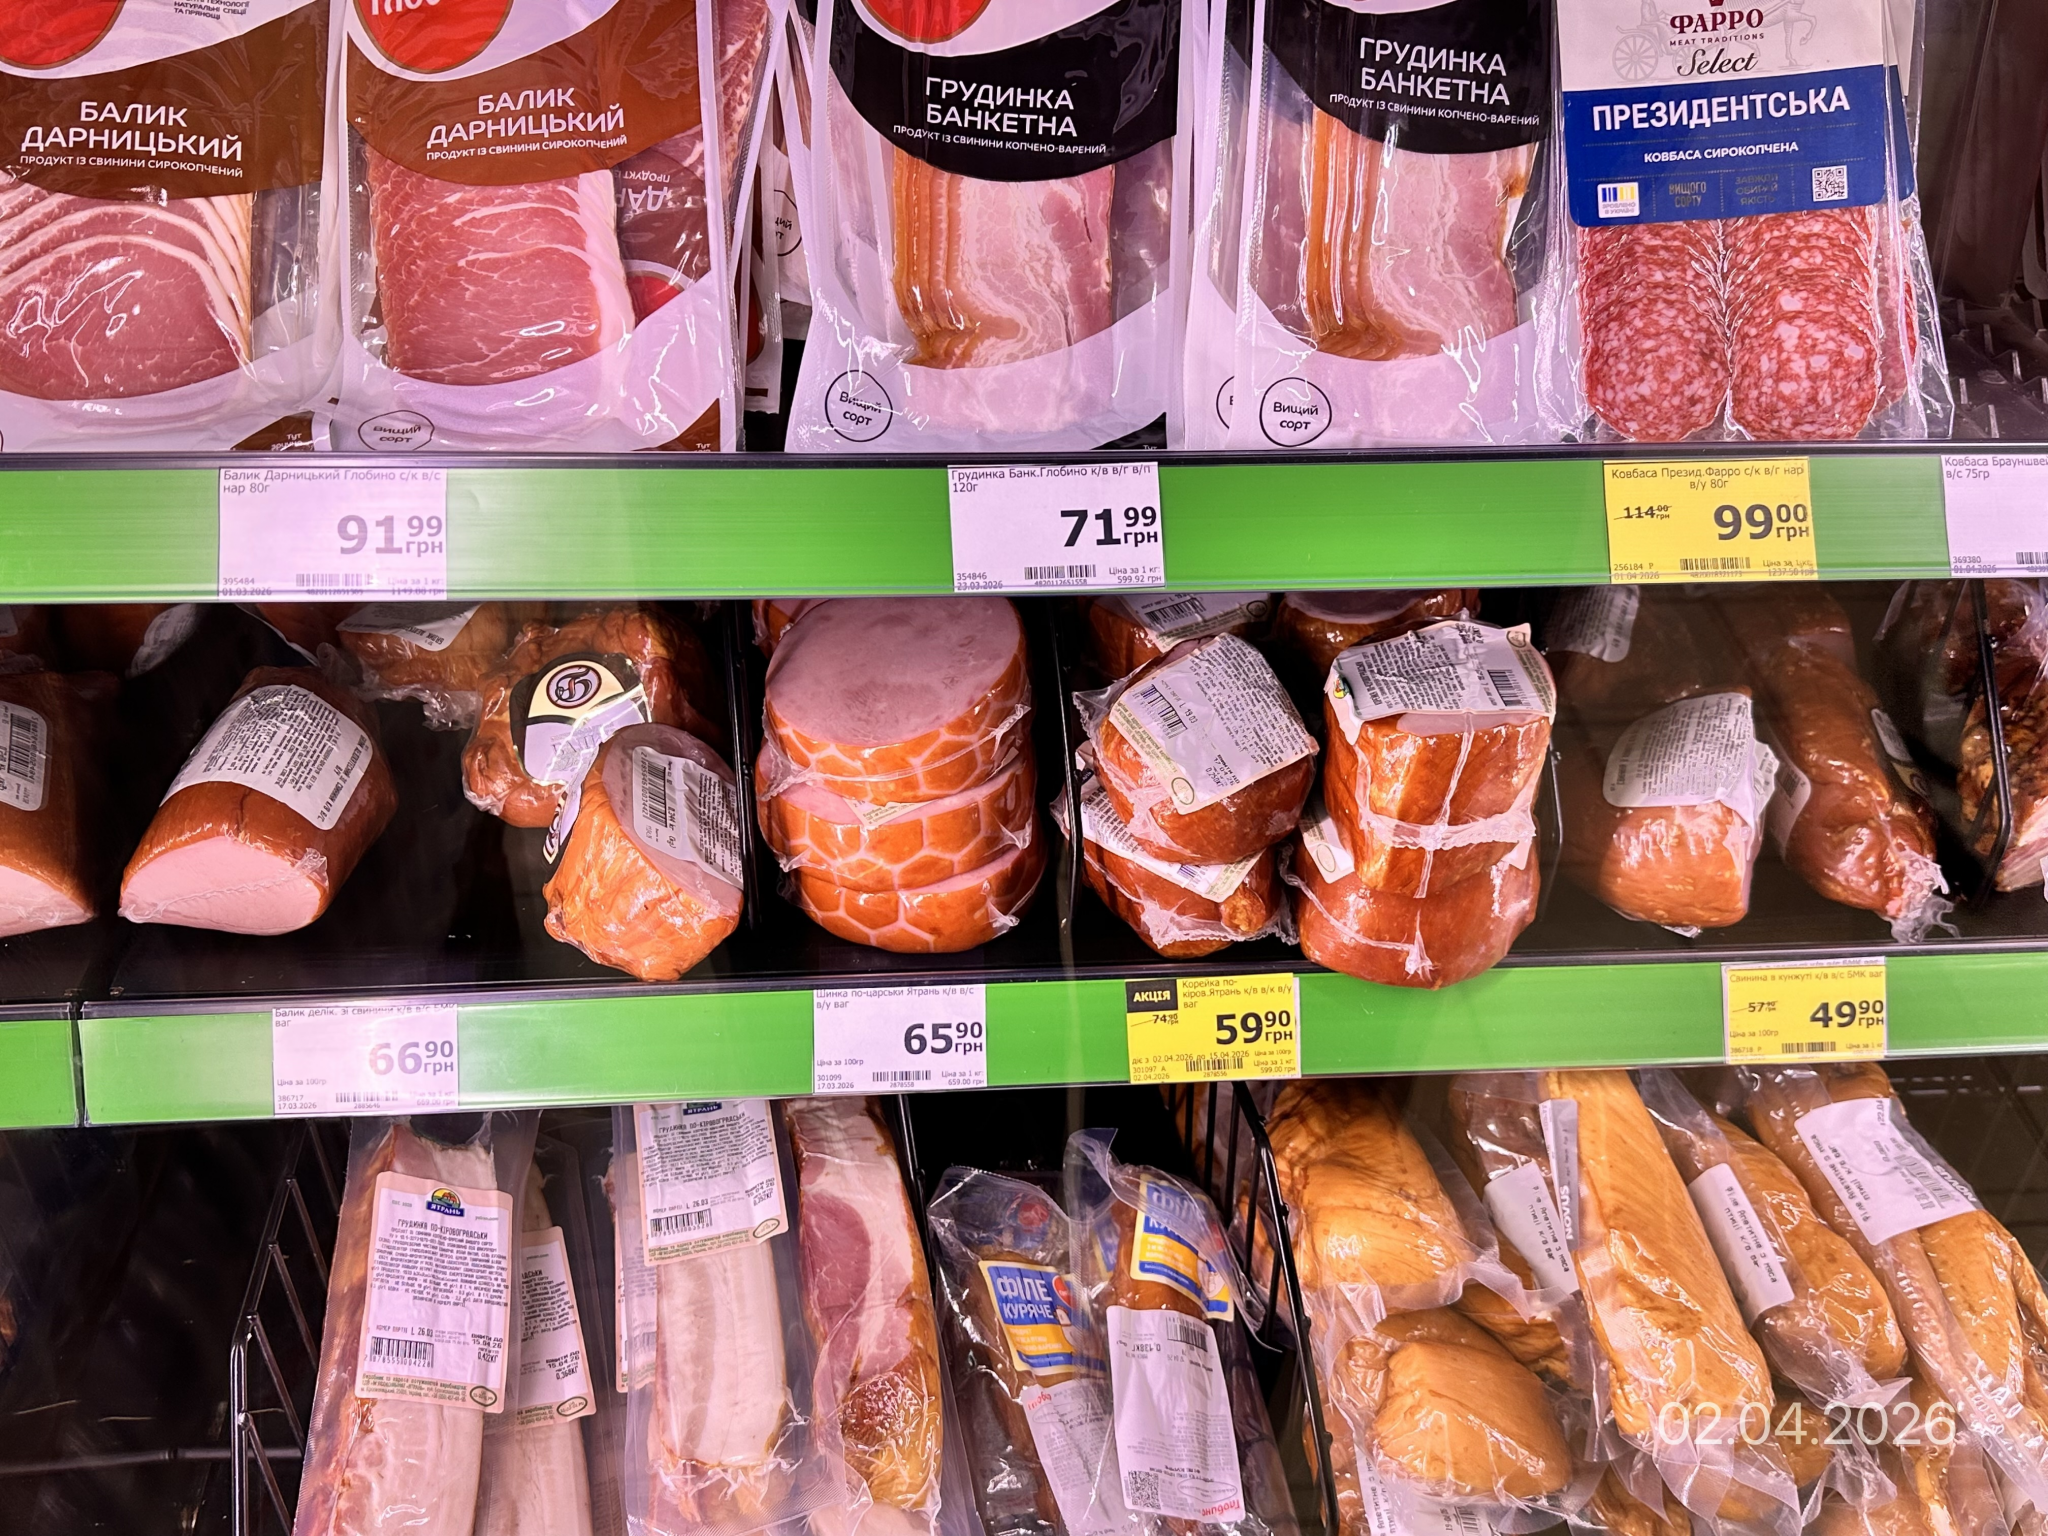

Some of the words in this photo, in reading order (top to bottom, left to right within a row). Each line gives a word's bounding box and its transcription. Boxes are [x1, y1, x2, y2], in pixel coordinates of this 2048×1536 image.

[1670, 8, 1764, 34] ФАРРО
[1670, 38, 1697, 46] MEAT
[1701, 33, 1765, 43] TRADITIONS
[1360, 37, 1506, 76] ГРУДИНКА
[1677, 48, 1759, 77] Select
[926, 76, 1074, 110] ГРУДИНКА
[1361, 67, 1510, 106] БАНКЕТНА
[478, 87, 575, 114] БАЛИК
[80, 101, 188, 127] БАЛИК
[1329, 94, 1374, 109] ПРОДУКТ
[1377, 101, 1385, 110] ІЗ
[1388, 102, 1436, 117] СВИНИНИ
[1438, 109, 1540, 125] КОПЧЕНО-ВАРЕНИЙ
[1593, 85, 1851, 131] ПРЕЗИДЕНТСЬКА
[427, 103, 624, 149] ДАРНИЦЬКИЙ
[927, 103, 1077, 137] БАНКЕТНА
[21, 126, 242, 161] ДАРНИЦЬКИЙ
[893, 125, 939, 141] ПРОДУКТ
[942, 134, 951, 143] ІЗ
[953, 135, 1003, 149] СВИНИНИ
[1005, 141, 1106, 154] КОПЧЕНО-ВАРЕНИЙ
[427, 148, 474, 160] ПРОДУКТ
[477, 148, 487, 156] ІЗ
[489, 142, 540, 155] СВИНИНИ
[542, 135, 627, 150] СИРОКОПЧЕНИЙ
[1644, 150, 1702, 163] КОВБАСА
[1704, 141, 1799, 160] СИРОКОПЧЕНА
[20, 156, 73, 167] ПРОДУКТ
[77, 157, 86, 165] ІЗ
[88, 157, 145, 168] СВИНИНИ
[148, 160, 243, 178] СИРОКОПЧЕНИЙ
[623, 170, 670, 183] ПРОДУКТ
[1669, 182, 1707, 195] ВИЩОГО
[1674, 195, 1702, 208] СОРТУ
[1273, 402, 1318, 416] Вищий
[843, 411, 872, 425] сорт
[1280, 420, 1311, 431] сорт
[1945, 457, 1988, 467] Ковбаса
[223, 470, 260, 480] Балик
[264, 470, 340, 482] Дарницький
[344, 470, 396, 480] Глобино
[400, 470, 418, 481] с/к
[422, 470, 441, 481] в/с
[951, 470, 1005, 481] Грудинка
[1009, 467, 1087, 479] Банк.Глобино
[1091, 466, 1108, 477] к/в
[1112, 465, 1129, 476] в/г
[1133, 465, 1150, 475] в/п
[1612, 468, 1657, 479] Ковбаса
[1662, 467, 1740, 479] Презид.Фарро
[1744, 466, 1761, 477] с/к
[1765, 466, 1780, 476] в/г
[1784, 466, 1804, 475] нар
[1946, 469, 1963, 480] в/с
[1966, 469, 1990, 480] 75гр
[223, 485, 245, 495] нар
[249, 483, 270, 493] 80г
[952, 482, 979, 492] 120г
[1690, 480, 1706, 490] в/у
[1710, 479, 1729, 489] 80г
[1623, 506, 1655, 519] 114
[1060, 508, 1121, 547] 71
[1124, 506, 1157, 527] 99
[1713, 504, 1773, 541] 99
[1776, 504, 1808, 523] 00
[337, 514, 403, 555] 91
[406, 515, 443, 537] 99
[1123, 531, 1158, 547] грн
[1776, 526, 1809, 541] грн
[406, 541, 443, 557] грн
[1109, 567, 1128, 575] Ціна
[1614, 563, 1643, 571] 256184
[957, 572, 987, 580] 354846
[1117, 575, 1145, 583] 599.92
[1730, 974, 1768, 982] Свинина
[1778, 972, 1812, 981] кунжуті
[1814, 971, 1828, 980] к/в
[1831, 970, 1844, 979] в/с
[1847, 970, 1866, 978] БМК
[1182, 979, 1220, 988] Корейка
[1223, 979, 1238, 987] по-
[1244, 987, 1258, 995] к/в
[1261, 986, 1275, 994] в/к
[1277, 985, 1292, 994] в/у
[816, 989, 848, 998] Шинка
[851, 989, 904, 997] по-царськи
[907, 988, 940, 996] Ятрань
[942, 987, 957, 995] к/в
[960, 986, 974, 994] в/с
[1133, 991, 1171, 1002] АКЦІЯ
[816, 1001, 831, 1010] в/у
[1748, 1002, 1764, 1012] 57
[275, 1008, 305, 1017] Балик
[308, 1008, 338, 1018] делік.
[1152, 1014, 1167, 1024] 74
[1809, 1001, 1856, 1028] 49
[1859, 1000, 1883, 1014] 90
[1216, 1012, 1263, 1045] 59
[1264, 1010, 1291, 1027] 90
[1859, 1017, 1884, 1028] грн
[904, 1023, 953, 1055] 65
[956, 1022, 983, 1038] 90
[1265, 1030, 1293, 1044] грн
[955, 1042, 983, 1055] грн
[368, 1042, 422, 1076] 66
[425, 1040, 454, 1058] 90
[844, 1058, 864, 1066] 100гр
[1152, 1054, 1194, 1063] 02.04.2026
[1209, 1051, 1250, 1060] 15.04.2026
[424, 1062, 454, 1076] грн
[1133, 1066, 1157, 1074] 301097
[1133, 1073, 1170, 1081] 02.04.2026
[278, 1102, 317, 1110] 17.03.2026
[1828, 1161, 1856, 1201] Апетитне
[1933, 1164, 1978, 1202] NOVUS
[430, 1204, 460, 1215] ЯТРАНЬ
[1559, 1185, 1573, 1240] NOVUS
[398, 1219, 427, 1229] ГРУДИНКА
[997, 1276, 1052, 1301] ФІЛЕ
[1003, 1303, 1054, 1319] КУРЯЧЕ
